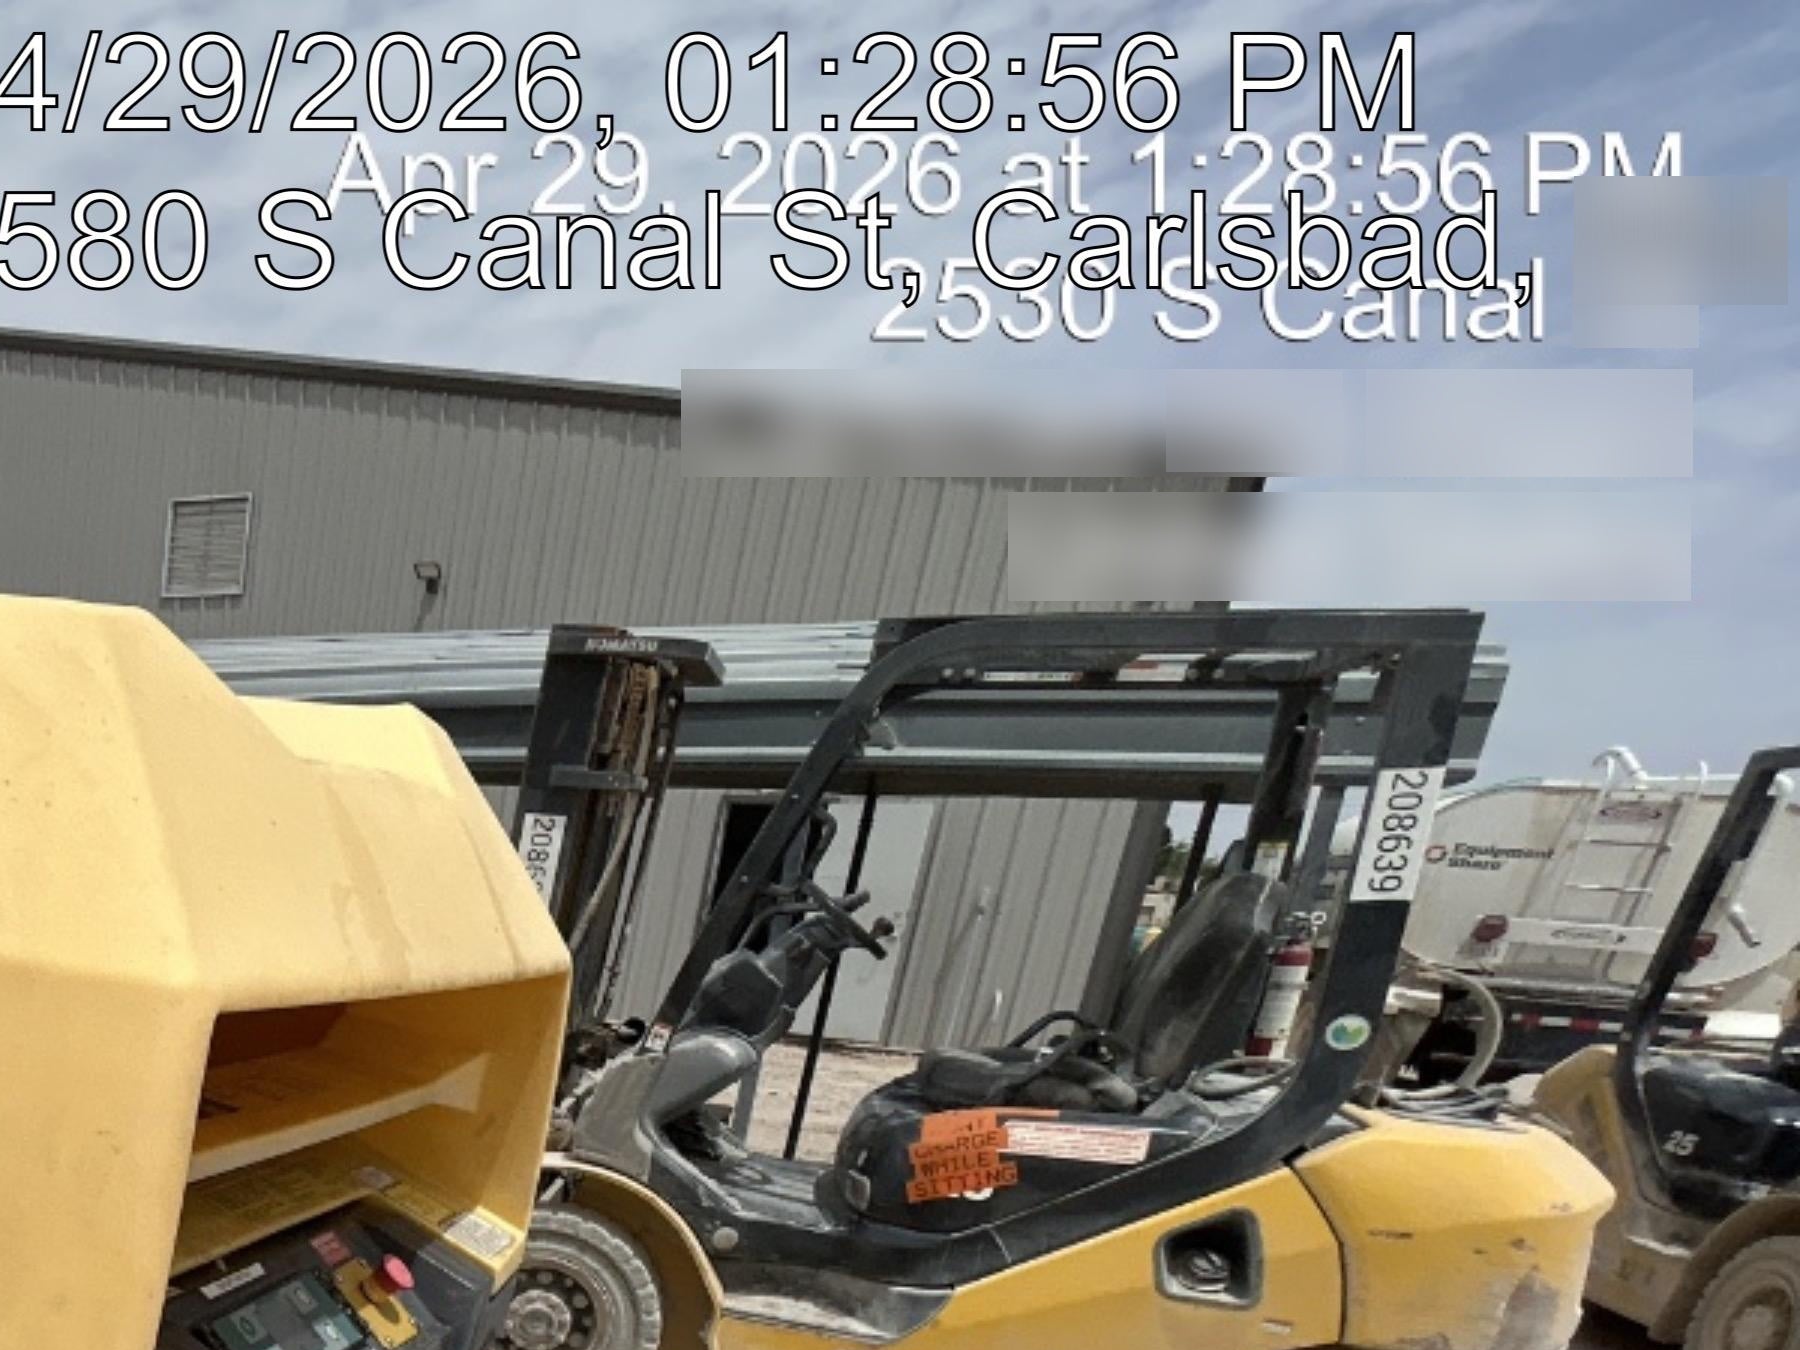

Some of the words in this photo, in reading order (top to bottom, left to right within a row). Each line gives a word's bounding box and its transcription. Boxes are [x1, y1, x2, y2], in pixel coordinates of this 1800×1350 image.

[1368, 770, 1428, 892] 208639
[1453, 843, 1555, 859] Equipment
[1663, 1130, 1700, 1156] 25
[913, 1165, 1018, 1198] SITTING
